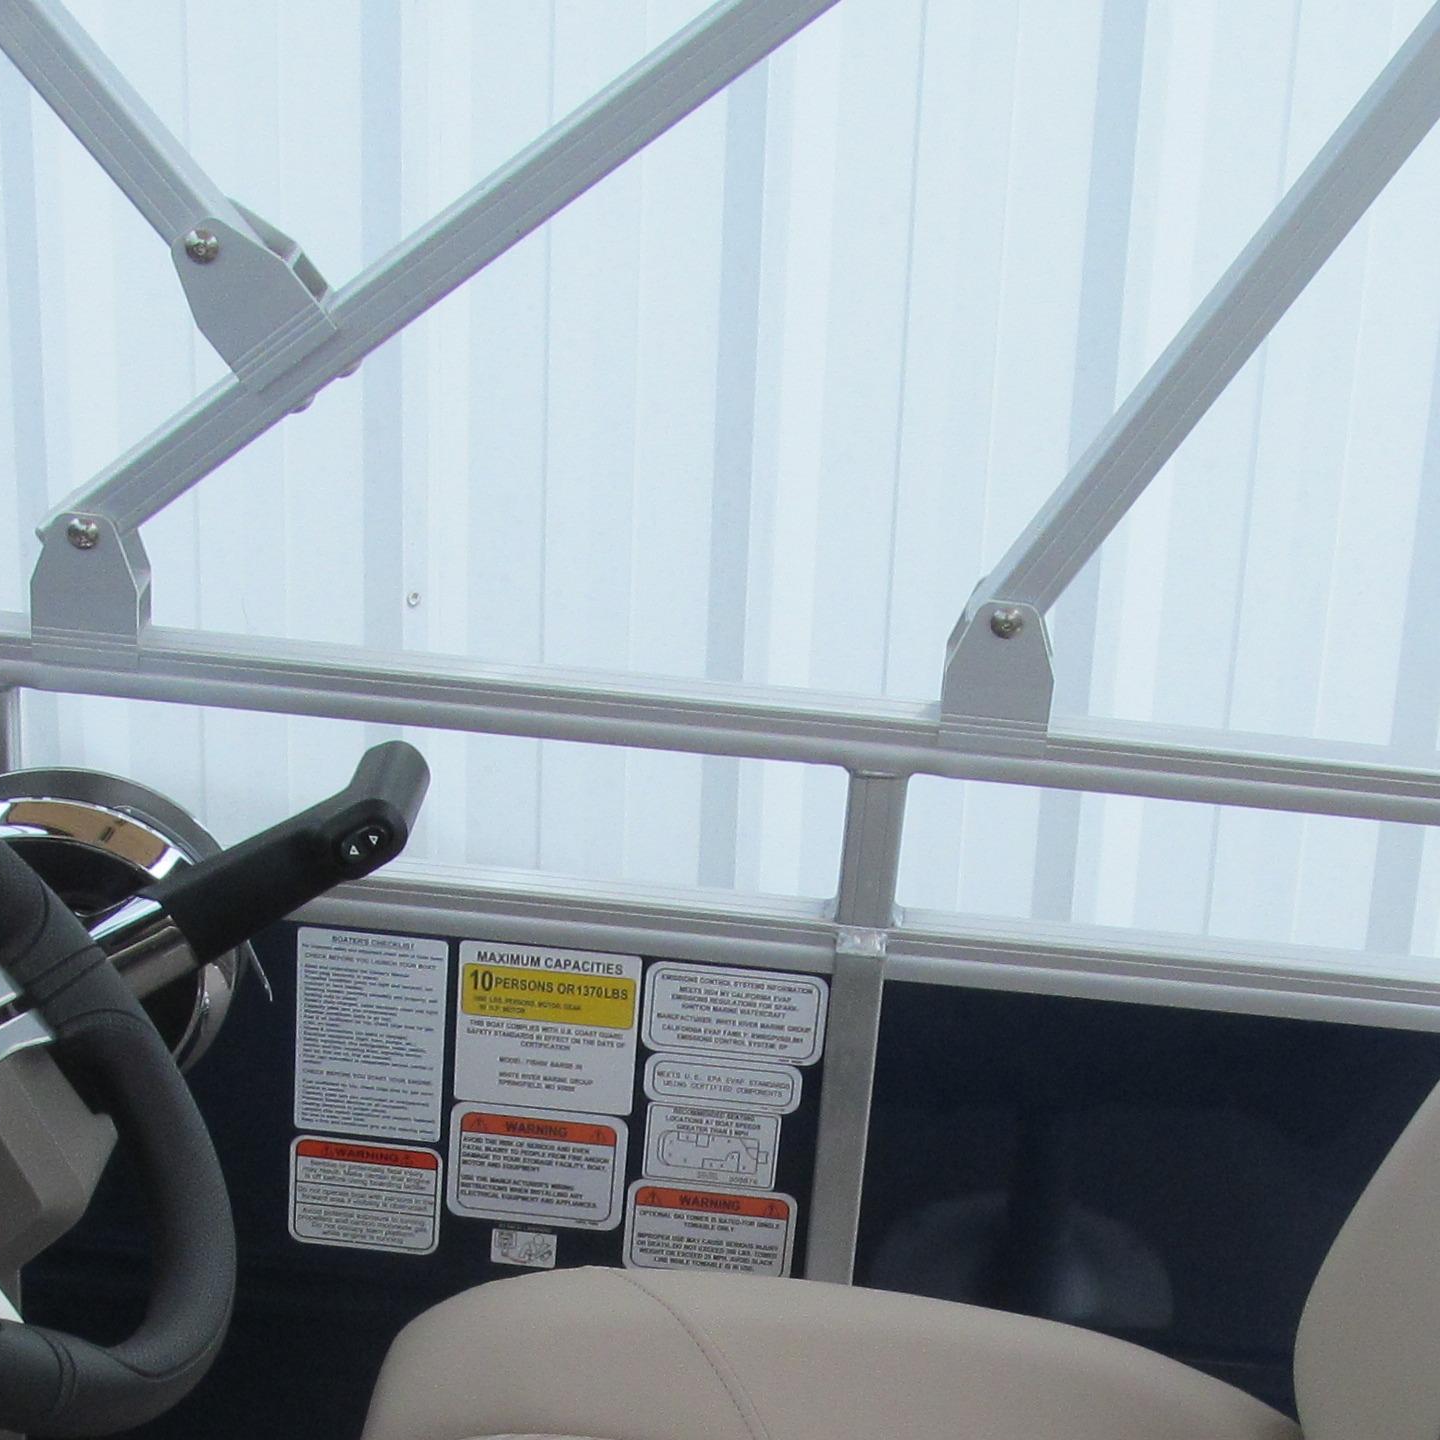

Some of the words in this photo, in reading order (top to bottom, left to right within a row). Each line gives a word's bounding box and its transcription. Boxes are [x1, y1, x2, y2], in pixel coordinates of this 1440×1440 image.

[476, 951, 540, 967] MAXIMUM
[544, 957, 623, 975] CAPACITIES
[469, 969, 492, 991] 10
[494, 976, 552, 993] PERSONS
[557, 982, 574, 995] OR
[576, 984, 602, 998] 1370
[604, 986, 628, 1000] LBS
[504, 1122, 567, 1137] WARNING
[334, 1147, 399, 1161] WARNING
[679, 1194, 740, 1211] WARNING
